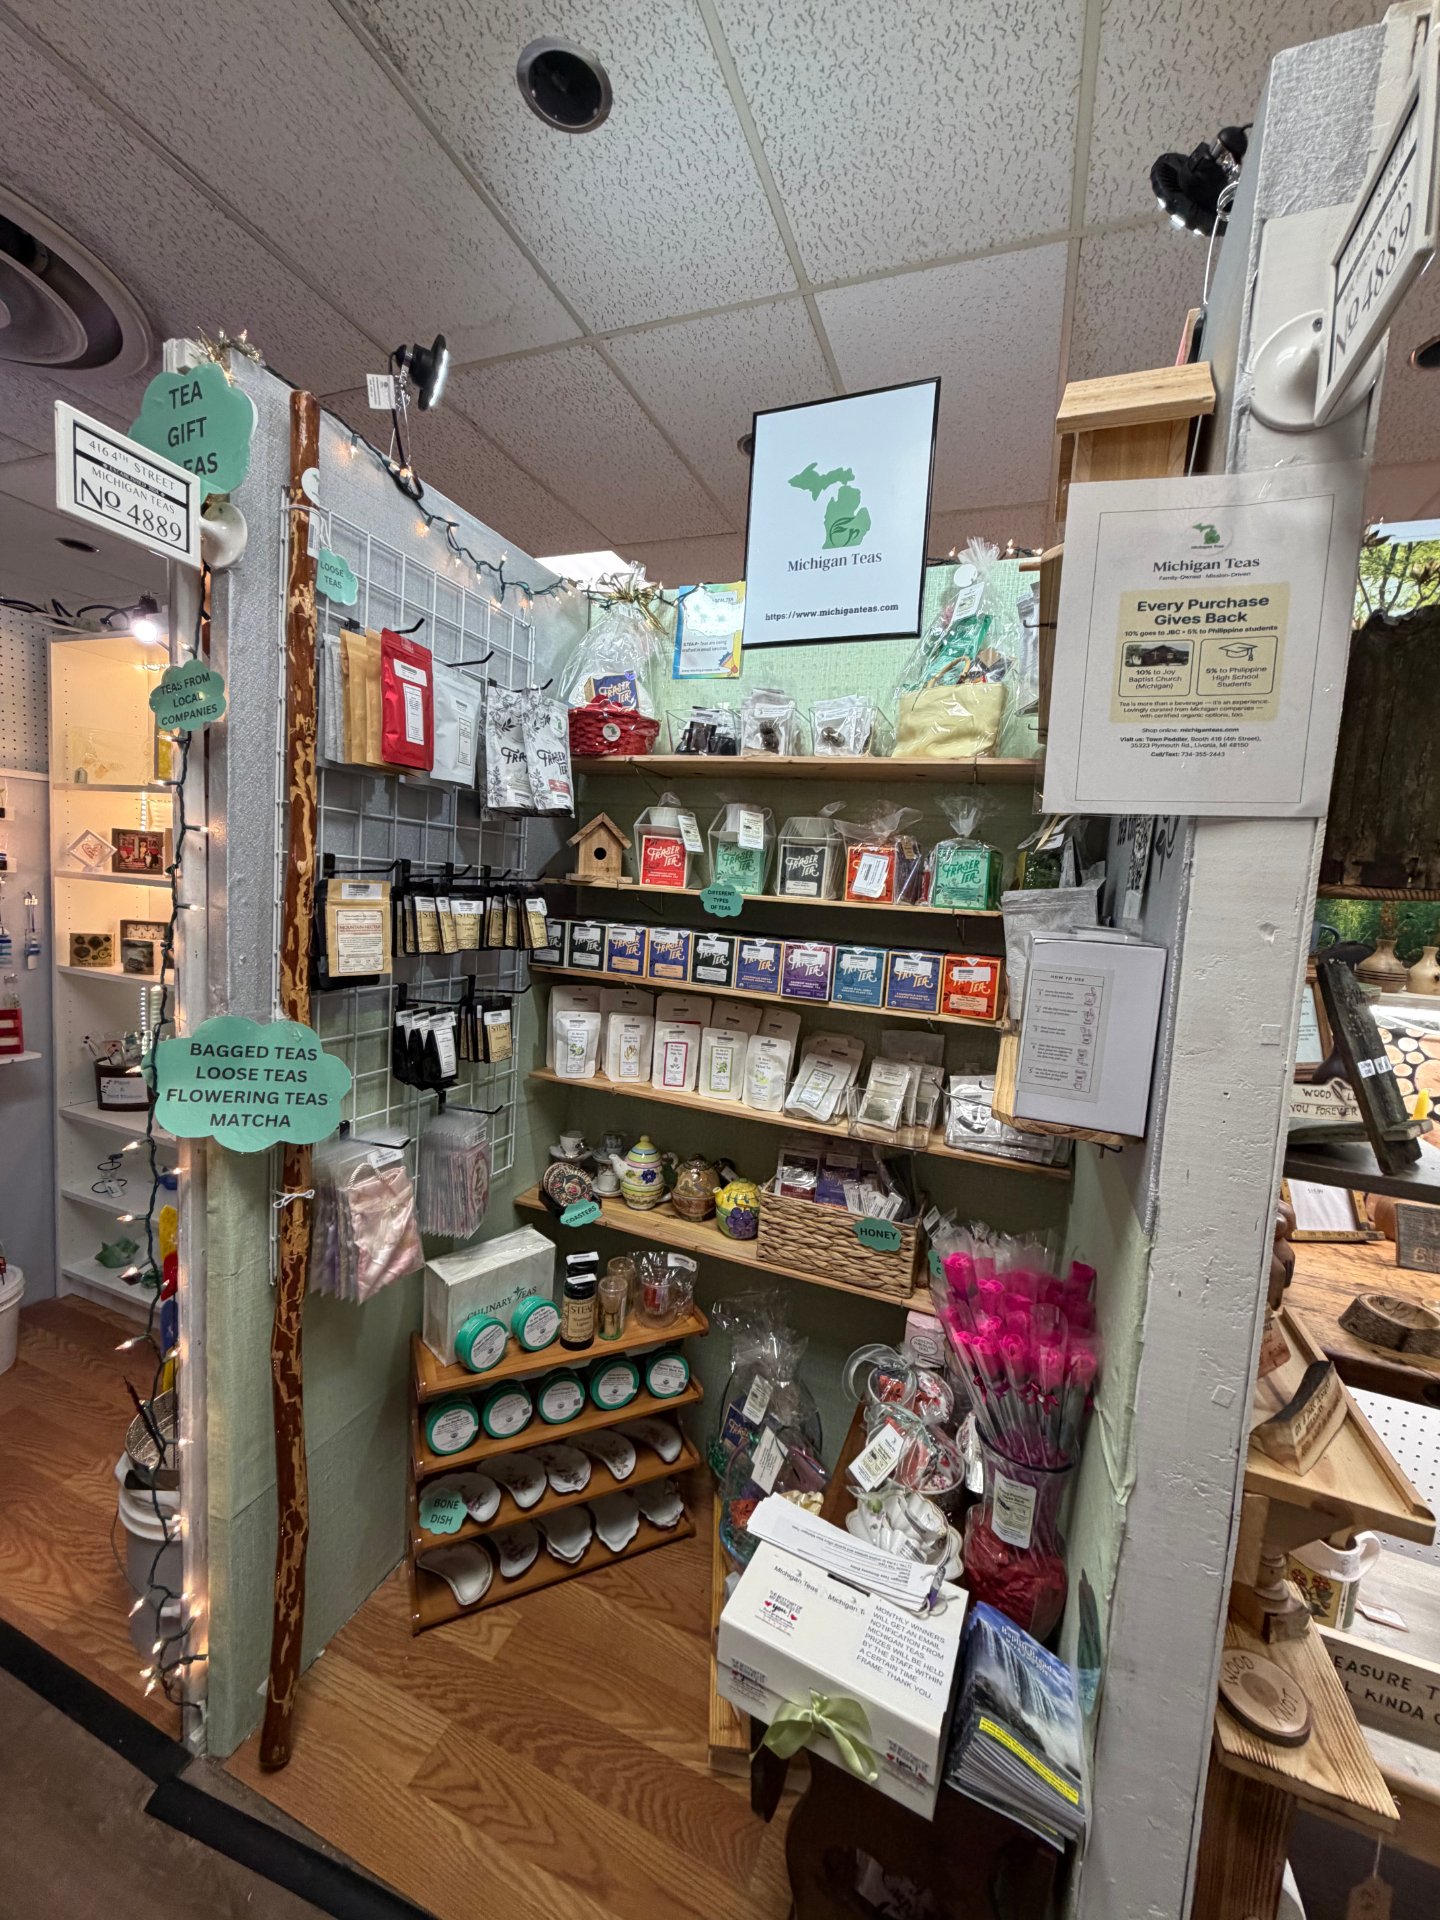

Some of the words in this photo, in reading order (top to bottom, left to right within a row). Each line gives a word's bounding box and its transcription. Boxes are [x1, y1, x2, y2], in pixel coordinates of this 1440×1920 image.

[1361, 202, 1412, 316] 4889
[169, 381, 203, 410] TEA
[167, 417, 207, 448] GIFT
[88, 440, 109, 457] 416
[134, 462, 176, 491] STREET
[181, 452, 218, 477] EAS
[92, 466, 148, 501] MICHIGAN
[150, 495, 175, 514] TEAS
[126, 504, 182, 542] 4889
[320, 561, 344, 578] LOOSE
[787, 554, 848, 573] Michigan
[851, 551, 883, 566] Teas
[1153, 559, 1221, 573] Michigan
[1225, 557, 1260, 569] Teas
[324, 575, 342, 589] TEAS
[765, 602, 899, 621] https://www.michiganteas.com
[1137, 600, 1184, 613] Every
[1187, 596, 1270, 611] Purchase
[1154, 613, 1201, 626] Gives
[1205, 611, 1249, 624] Back
[1208, 626, 1244, 635] Philippine
[1245, 625, 1279, 633] students
[1128, 676, 1154, 684] Baptist
[1155, 675, 1182, 683] Church
[1163, 669, 1176, 677] Joy
[1212, 674, 1231, 682] High
[1231, 673, 1259, 681] School
[1229, 666, 1268, 675] Philippine
[160, 681, 183, 696] TEAS
[183, 672, 211, 688] FROM
[1135, 683, 1174, 691] (Michigan)
[1217, 680, 1252, 688] Students
[173, 692, 203, 708] LOCAL
[161, 704, 218, 726] COMPANIES
[647, 845, 681, 862] FRASER
[785, 854, 819, 871] FRASER
[942, 859, 980, 878] FRASER
[707, 889, 735, 897] DIFFERENT
[190, 1042, 269, 1059] BAGGED
[274, 1046, 318, 1061] TEAS
[196, 1066, 259, 1081] LOOSE
[263, 1068, 308, 1083] TEAS
[166, 1088, 280, 1105] FLOWERING
[284, 1091, 329, 1106] TEAS
[1301, 1088, 1332, 1099] WOOD
[1290, 1103, 1309, 1114] YOU
[1315, 1106, 1359, 1117] FOREVER
[209, 1113, 292, 1128] MATCHA
[565, 1205, 597, 1224] COASTERS
[860, 1227, 898, 1240] HONEY
[433, 1498, 460, 1510] BONE
[430, 1514, 454, 1526] DISH
[774, 1565, 802, 1585] Michigan
[803, 1580, 819, 1594] Teas
[827, 1593, 859, 1612] Michigan
[873, 1611, 889, 1625] WILL
[890, 1620, 906, 1633] GET
[906, 1629, 918, 1639] AN
[918, 1634, 941, 1650] EMAIL
[876, 1605, 910, 1625] MONTHLY
[910, 1622, 945, 1644] WINNERS
[867, 1626, 904, 1649] MICHIGAN
[870, 1618, 921, 1648] NOTIFICATION
[921, 1643, 944, 1661] FROM
[862, 1640, 873, 1649] BY
[874, 1644, 889, 1658] THE
[890, 1653, 914, 1671] STAFF
[914, 1665, 943, 1687] WITHIN
[864, 1632, 891, 1651] PRIZES
[892, 1646, 910, 1661] WILL
[911, 1656, 922, 1667] BE
[923, 1662, 945, 1678] HELD
[865, 1650, 898, 1672] CERTAIN
[886, 1670, 913, 1690] THANK
[1223, 1655, 1255, 1686] WOOD
[1364, 1688, 1424, 1720] KINDA
